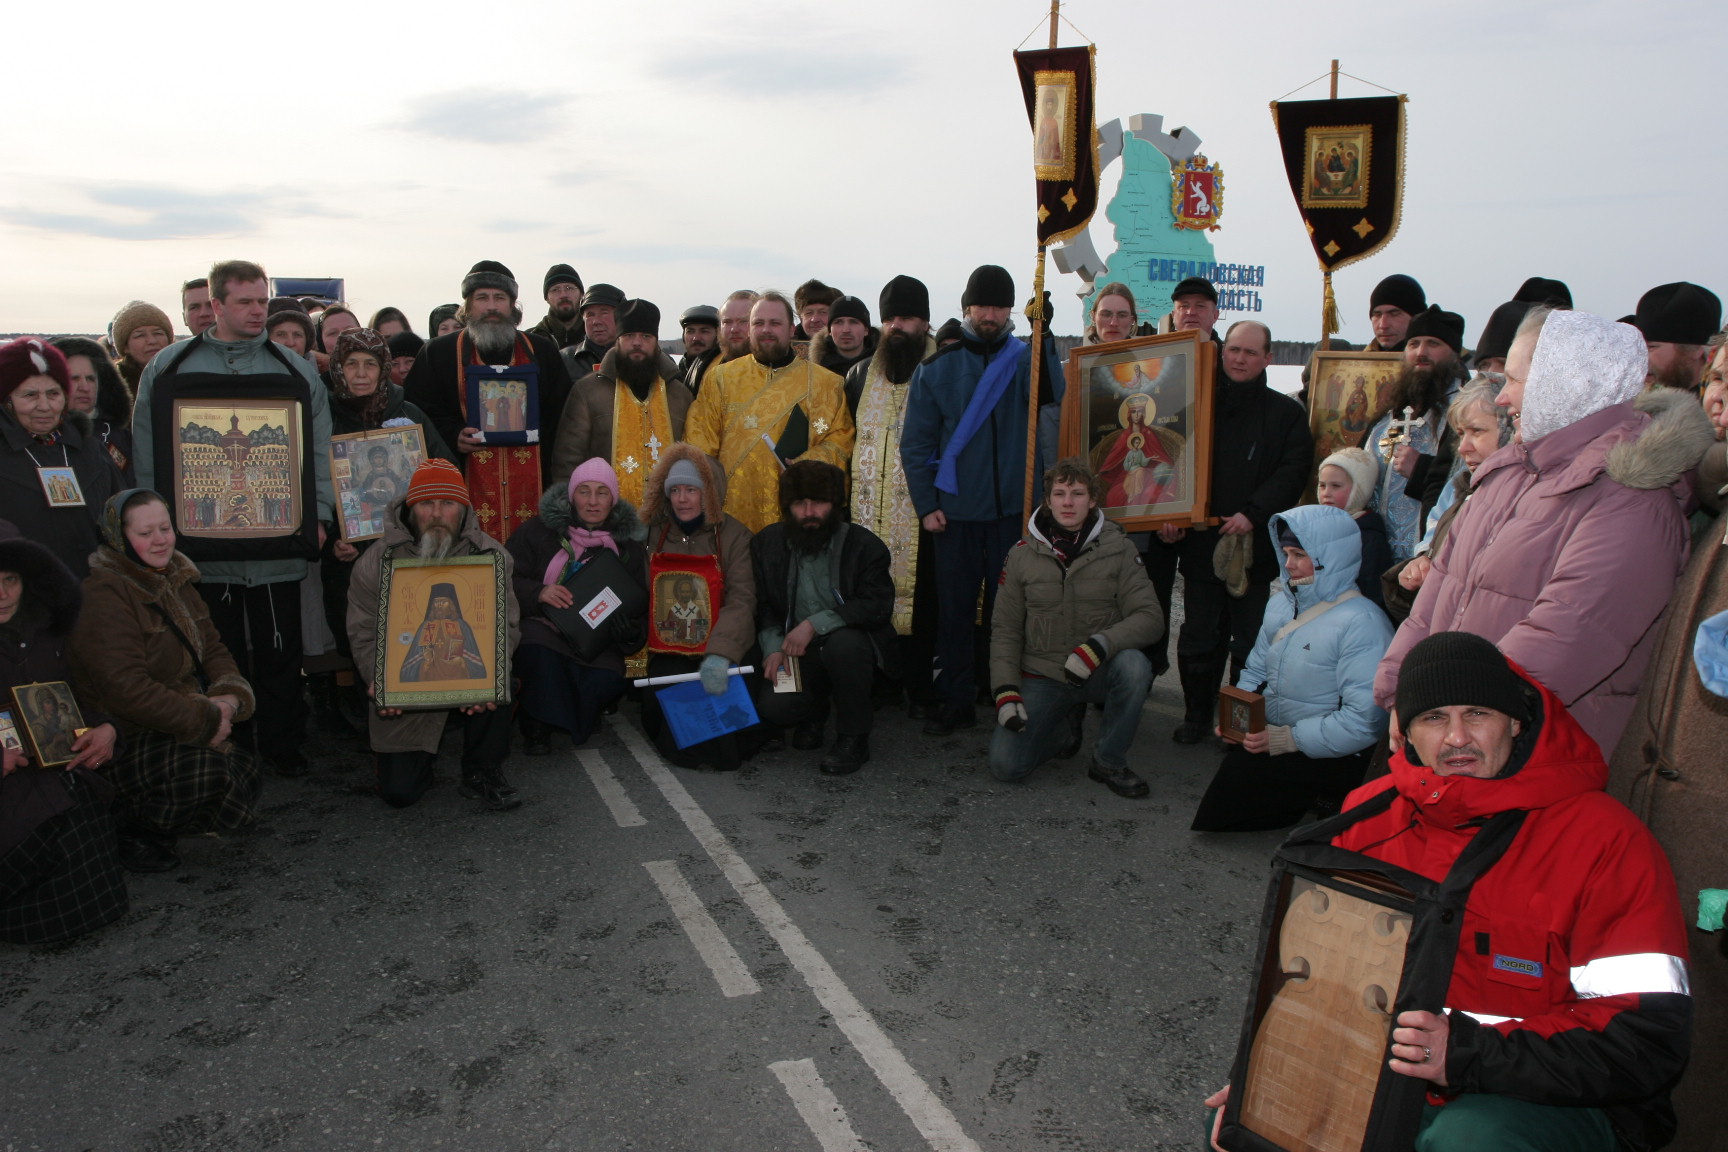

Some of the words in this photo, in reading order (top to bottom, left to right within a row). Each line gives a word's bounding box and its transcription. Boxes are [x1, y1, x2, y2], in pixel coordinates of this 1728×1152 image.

[1149, 258, 1264, 287] СВЕРДЛОВСКАЯ
[1216, 288, 1262, 312] ЛАСТЬ
[1501, 959, 1534, 972] NORD
